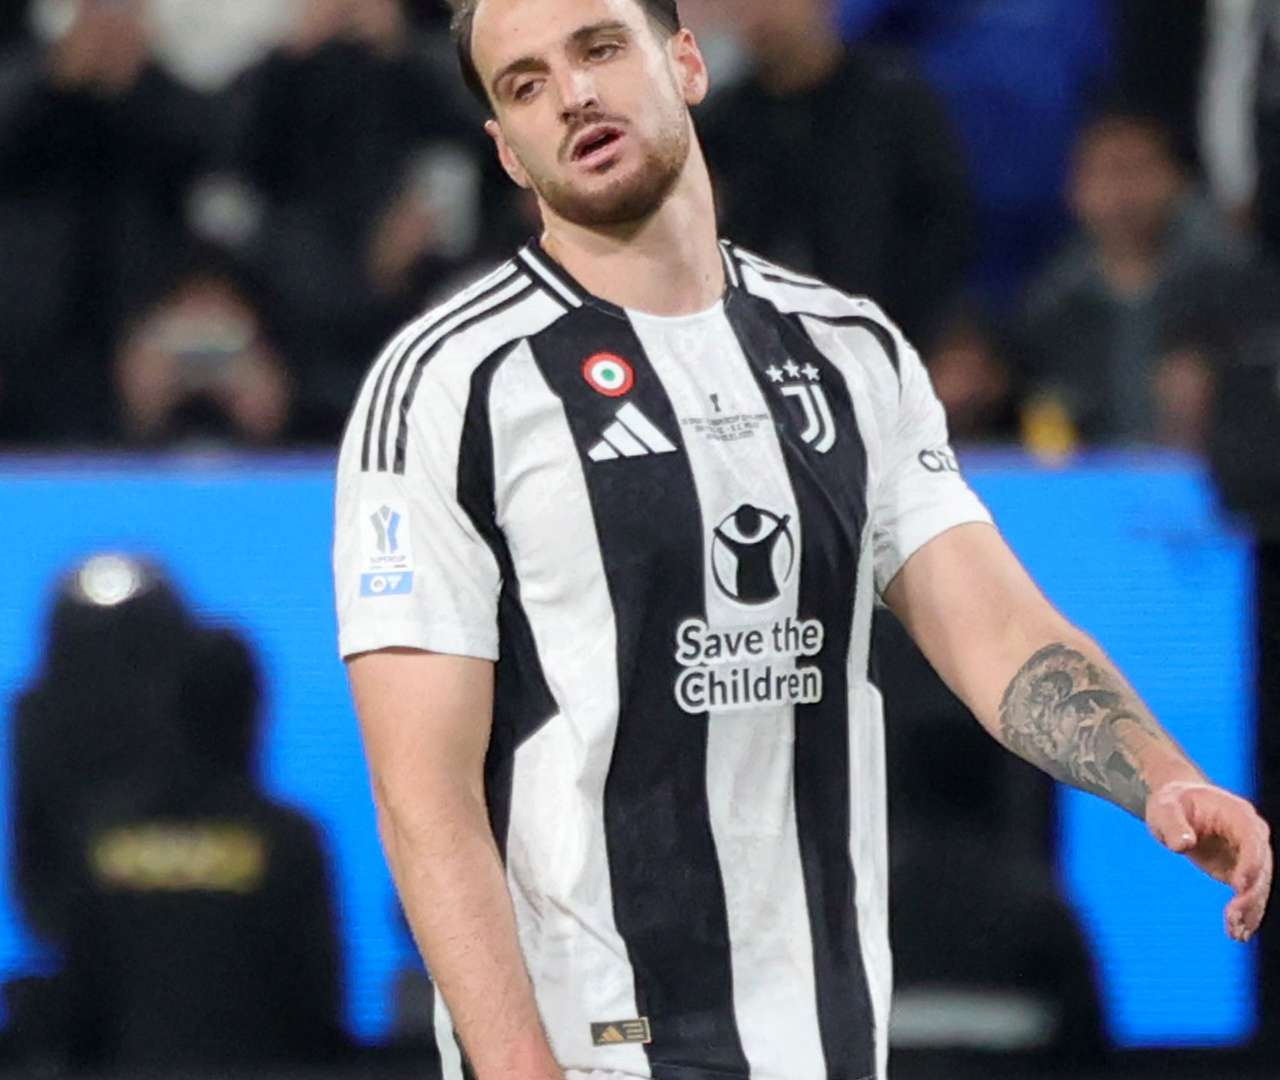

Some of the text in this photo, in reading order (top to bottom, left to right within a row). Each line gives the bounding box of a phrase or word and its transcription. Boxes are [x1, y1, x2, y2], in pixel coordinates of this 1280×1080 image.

[681, 616, 819, 661] Save the
[680, 665, 819, 708] Children
